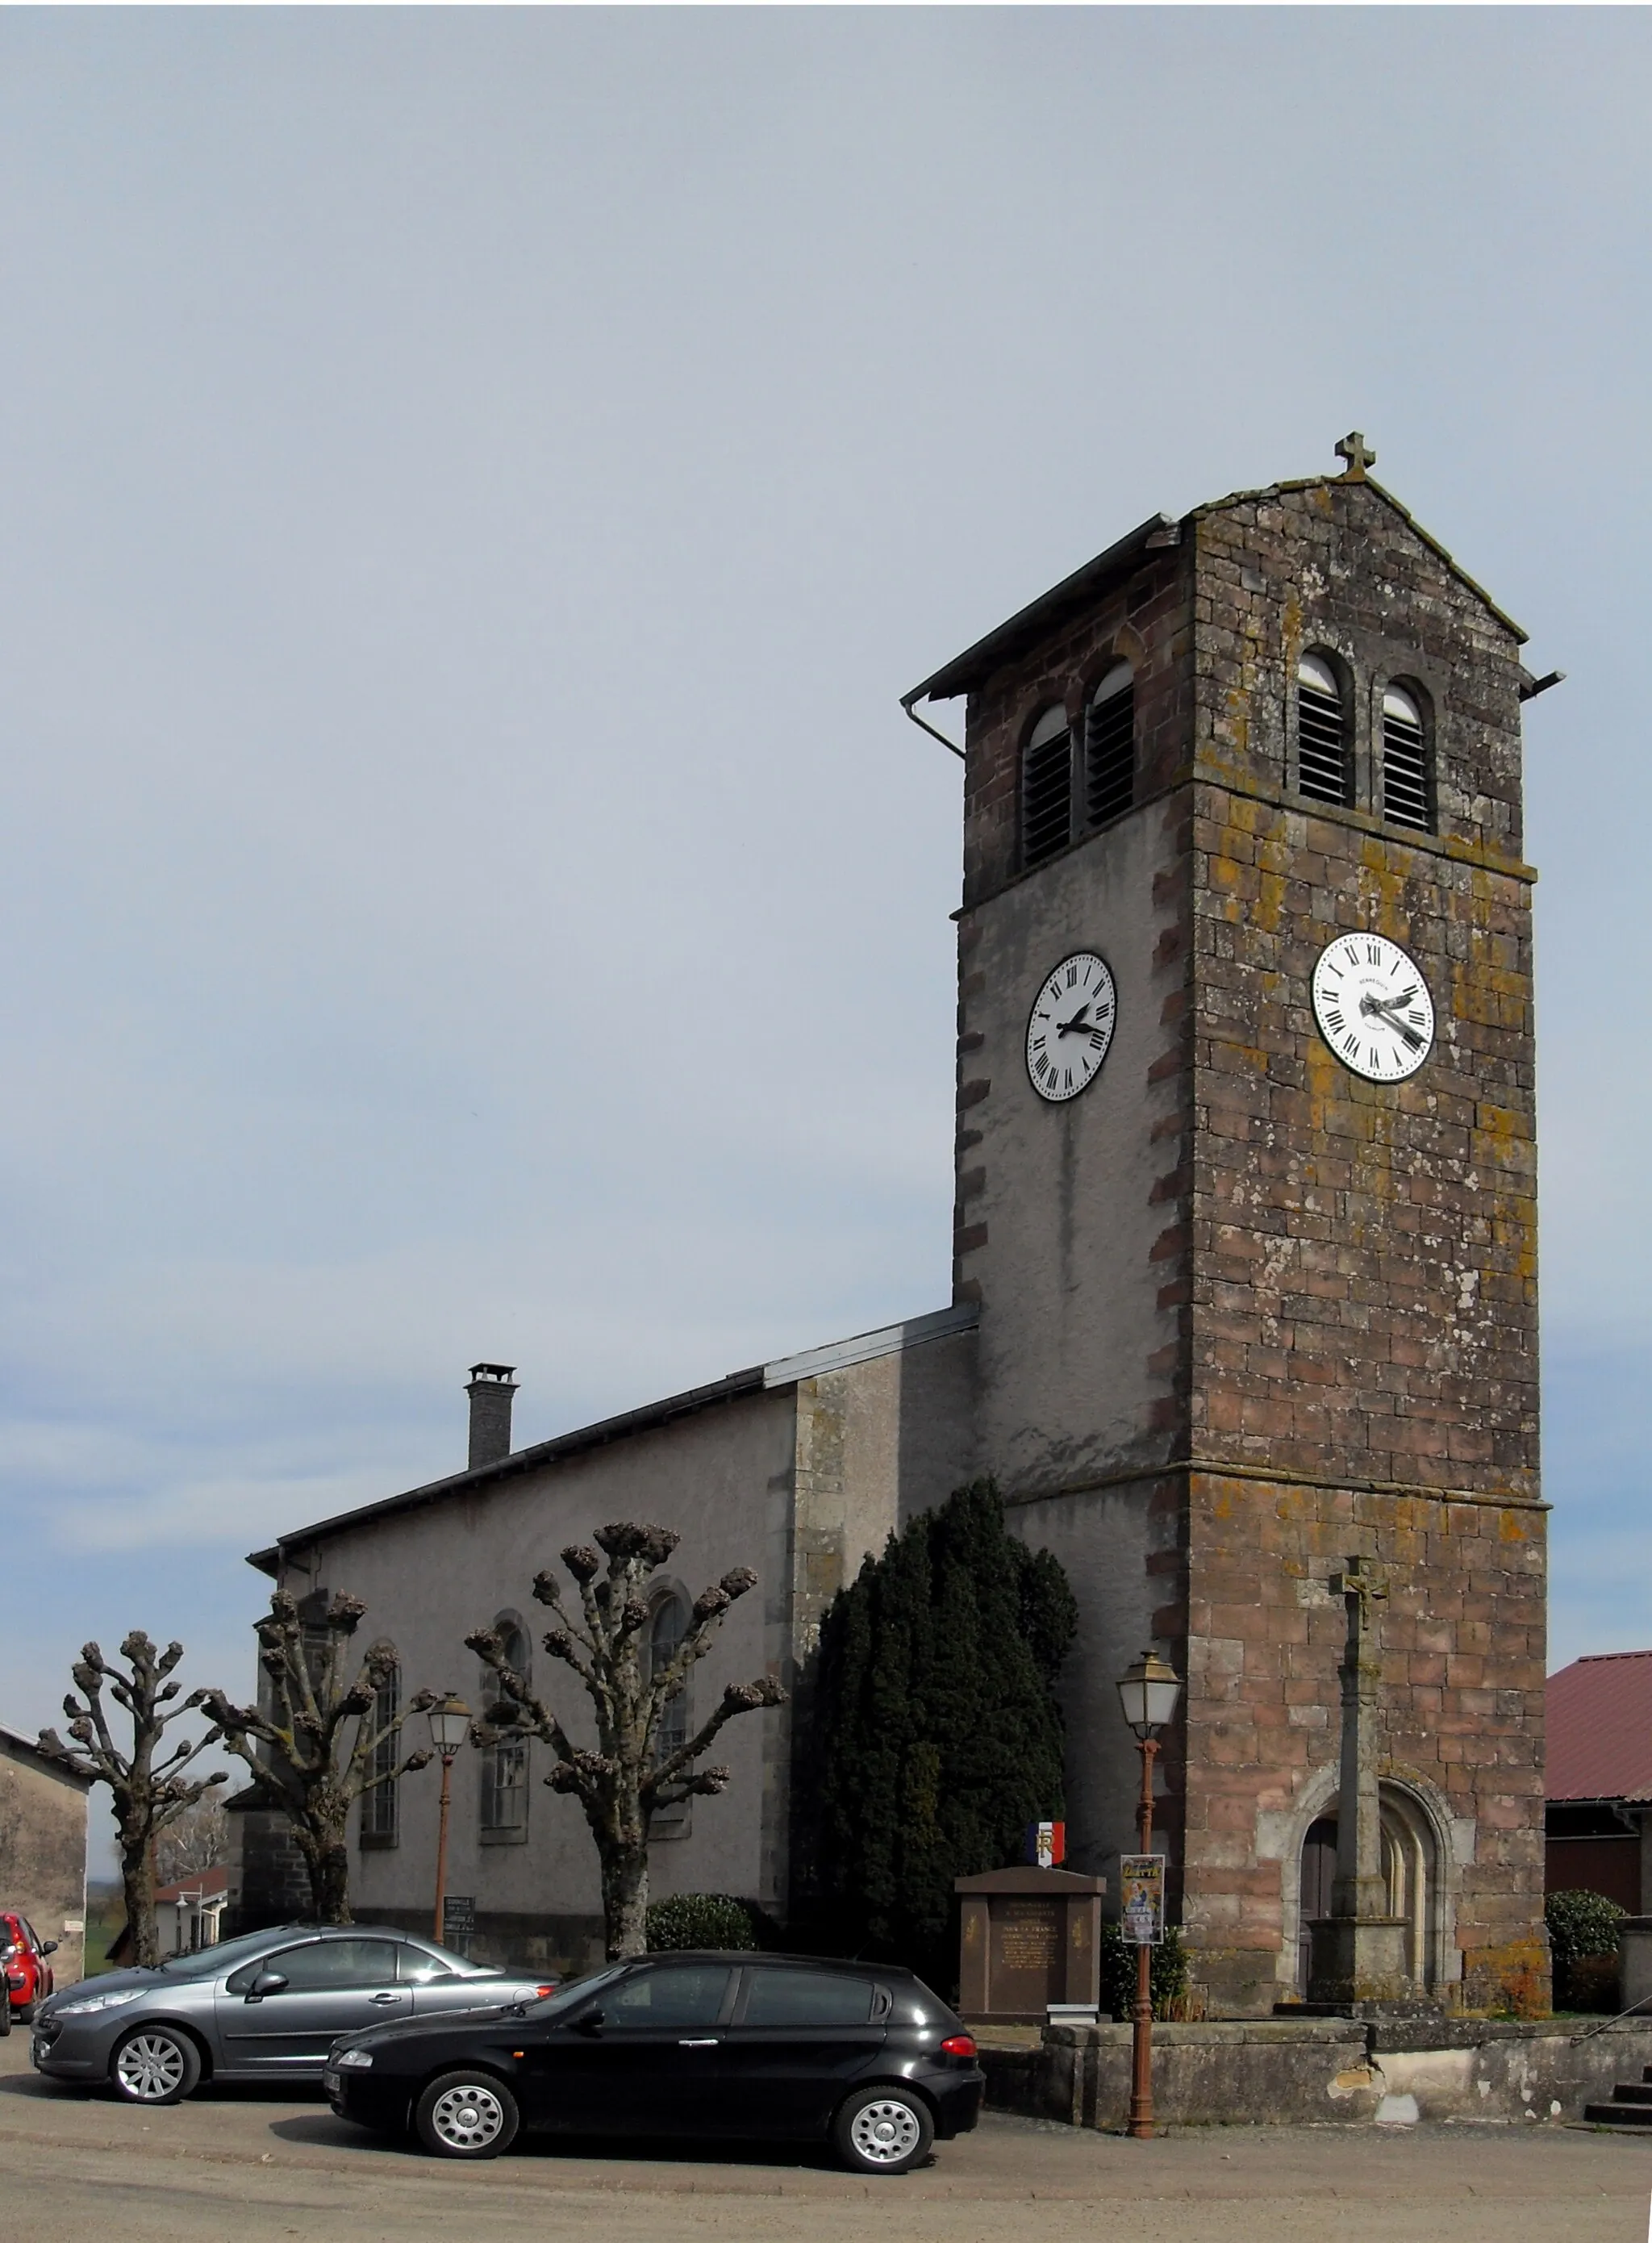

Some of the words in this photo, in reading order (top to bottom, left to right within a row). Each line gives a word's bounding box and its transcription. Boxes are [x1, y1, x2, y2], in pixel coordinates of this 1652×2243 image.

[1345, 945, 1360, 966] XI
[1367, 944, 1381, 966] XII
[1066, 965, 1077, 988] XII
[1083, 965, 1091, 986] I
[1328, 963, 1344, 979] X
[1391, 961, 1400, 975] I
[1050, 981, 1062, 1002] XI
[1092, 978, 1105, 998] II
[1321, 988, 1339, 1003] IX
[1402, 984, 1419, 996] II
[1038, 1011, 1050, 1021] X
[1096, 1003, 1109, 1021] III
[1325, 1009, 1346, 1034] VIII
[1408, 1010, 1425, 1025] III
[1033, 1034, 1045, 1051] IX
[1343, 1034, 1361, 1058] VII
[1034, 1051, 1050, 1080] VIII
[1082, 1056, 1091, 1073] V
[1370, 1047, 1379, 1069] VI
[1393, 1046, 1403, 1067] V
[1046, 1067, 1059, 1090] VII
[1065, 1067, 1073, 1089] VI
